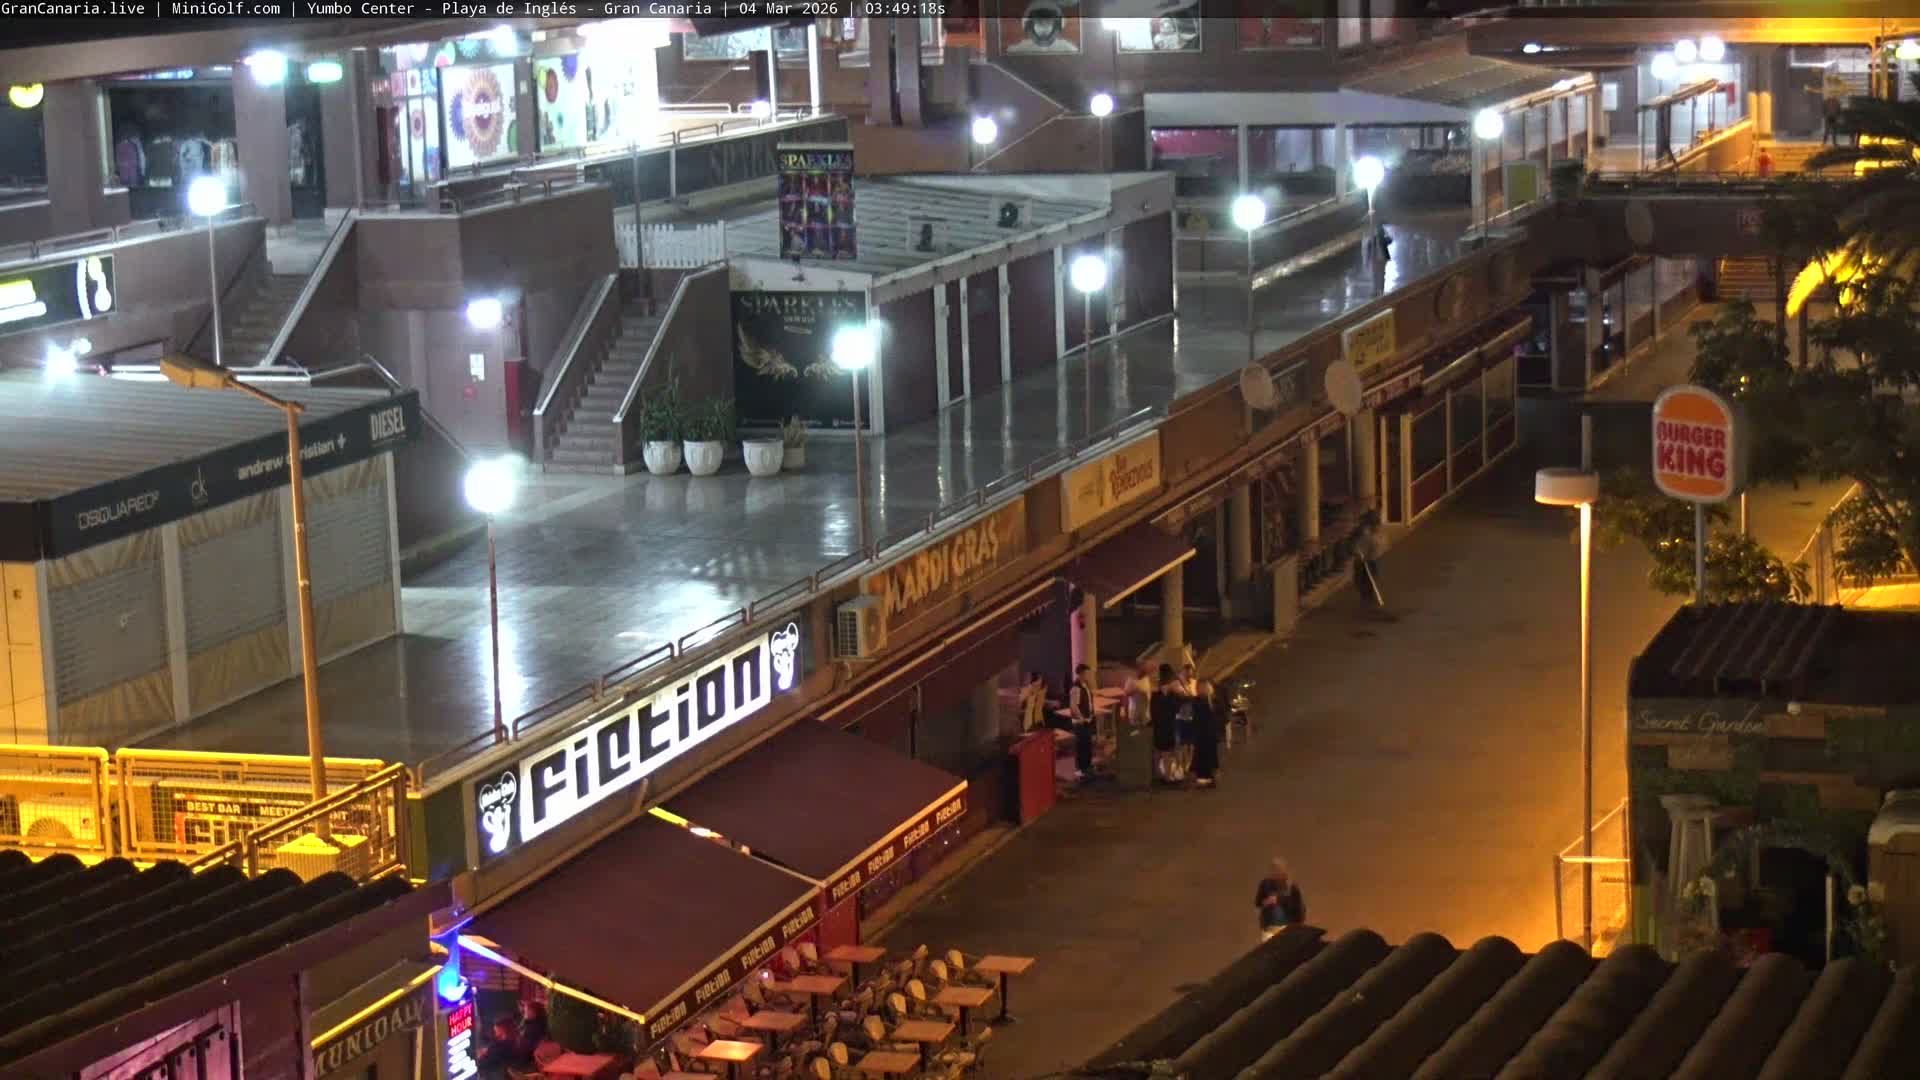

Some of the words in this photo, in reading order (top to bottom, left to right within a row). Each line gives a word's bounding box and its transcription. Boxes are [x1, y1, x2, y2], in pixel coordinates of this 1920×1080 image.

[369, 405, 406, 442] DIESEL
[1656, 421, 1726, 449] BURGER
[237, 454, 285, 481] andrew
[1657, 442, 1726, 480] KING
[879, 545, 949, 624] MARDI
[952, 514, 999, 578] GRAS
[1636, 708, 1691, 730] Secret
[187, 801, 215, 813] BEST
[218, 804, 241, 815] BAR
[449, 1003, 472, 1026] HAPPY
[451, 1016, 472, 1037] HOUR
